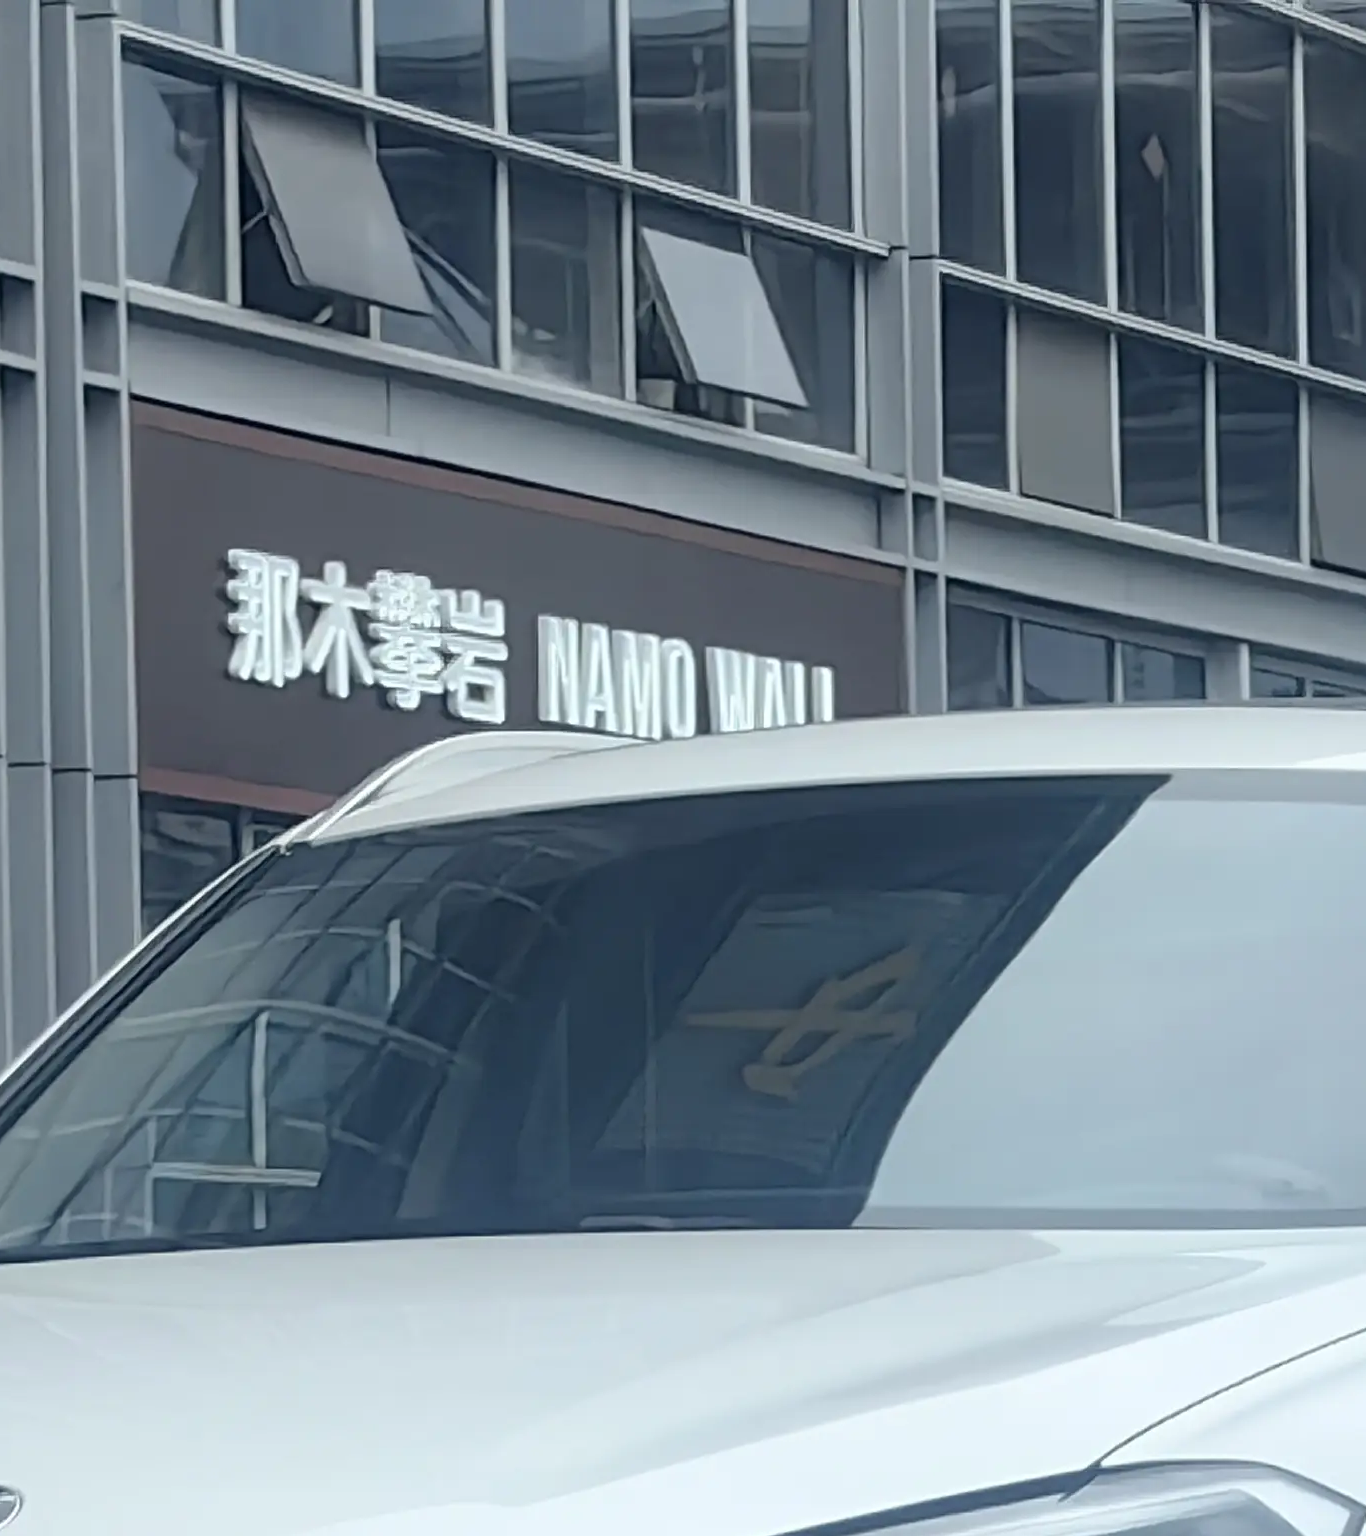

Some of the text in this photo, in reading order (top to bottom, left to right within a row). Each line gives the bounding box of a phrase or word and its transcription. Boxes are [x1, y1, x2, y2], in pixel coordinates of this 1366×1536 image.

[224, 547, 508, 726] 那木攀岩
[536, 614, 696, 741] NAMO
